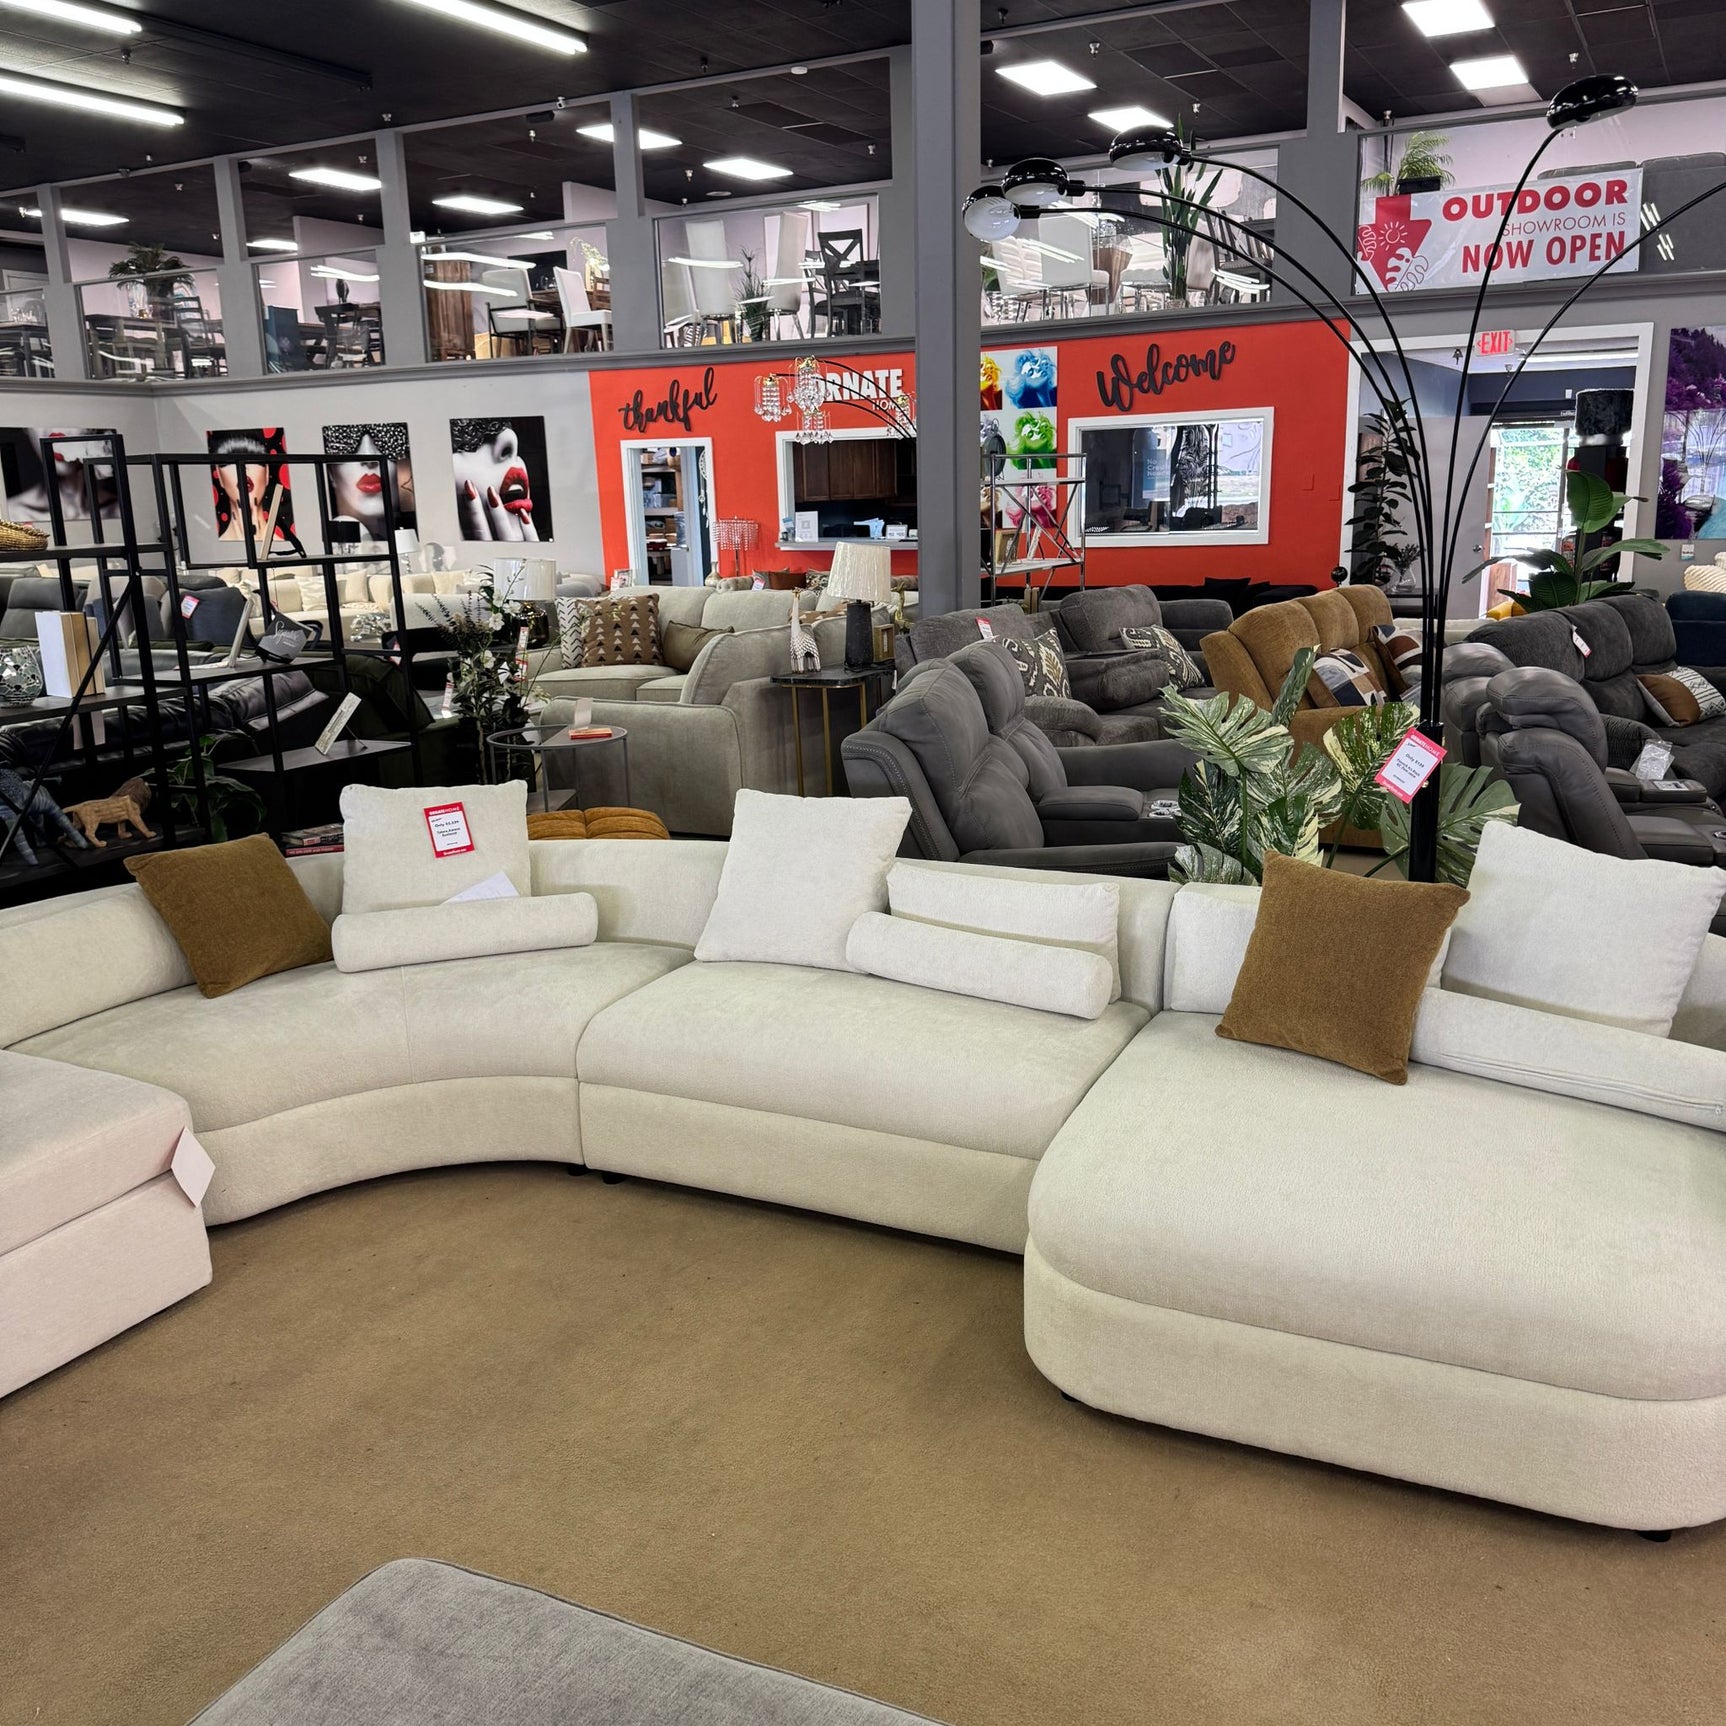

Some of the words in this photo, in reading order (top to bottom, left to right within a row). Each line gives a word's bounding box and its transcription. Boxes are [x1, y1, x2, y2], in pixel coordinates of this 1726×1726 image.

[1442, 180, 1628, 221] OUTDOOR
[1612, 211, 1626, 226] IS
[1461, 239, 1534, 274] NOW
[1546, 230, 1626, 266] OPEN
[1481, 331, 1509, 354] EXIT
[1096, 341, 1236, 412] Welcome
[618, 366, 718, 433] thankful
